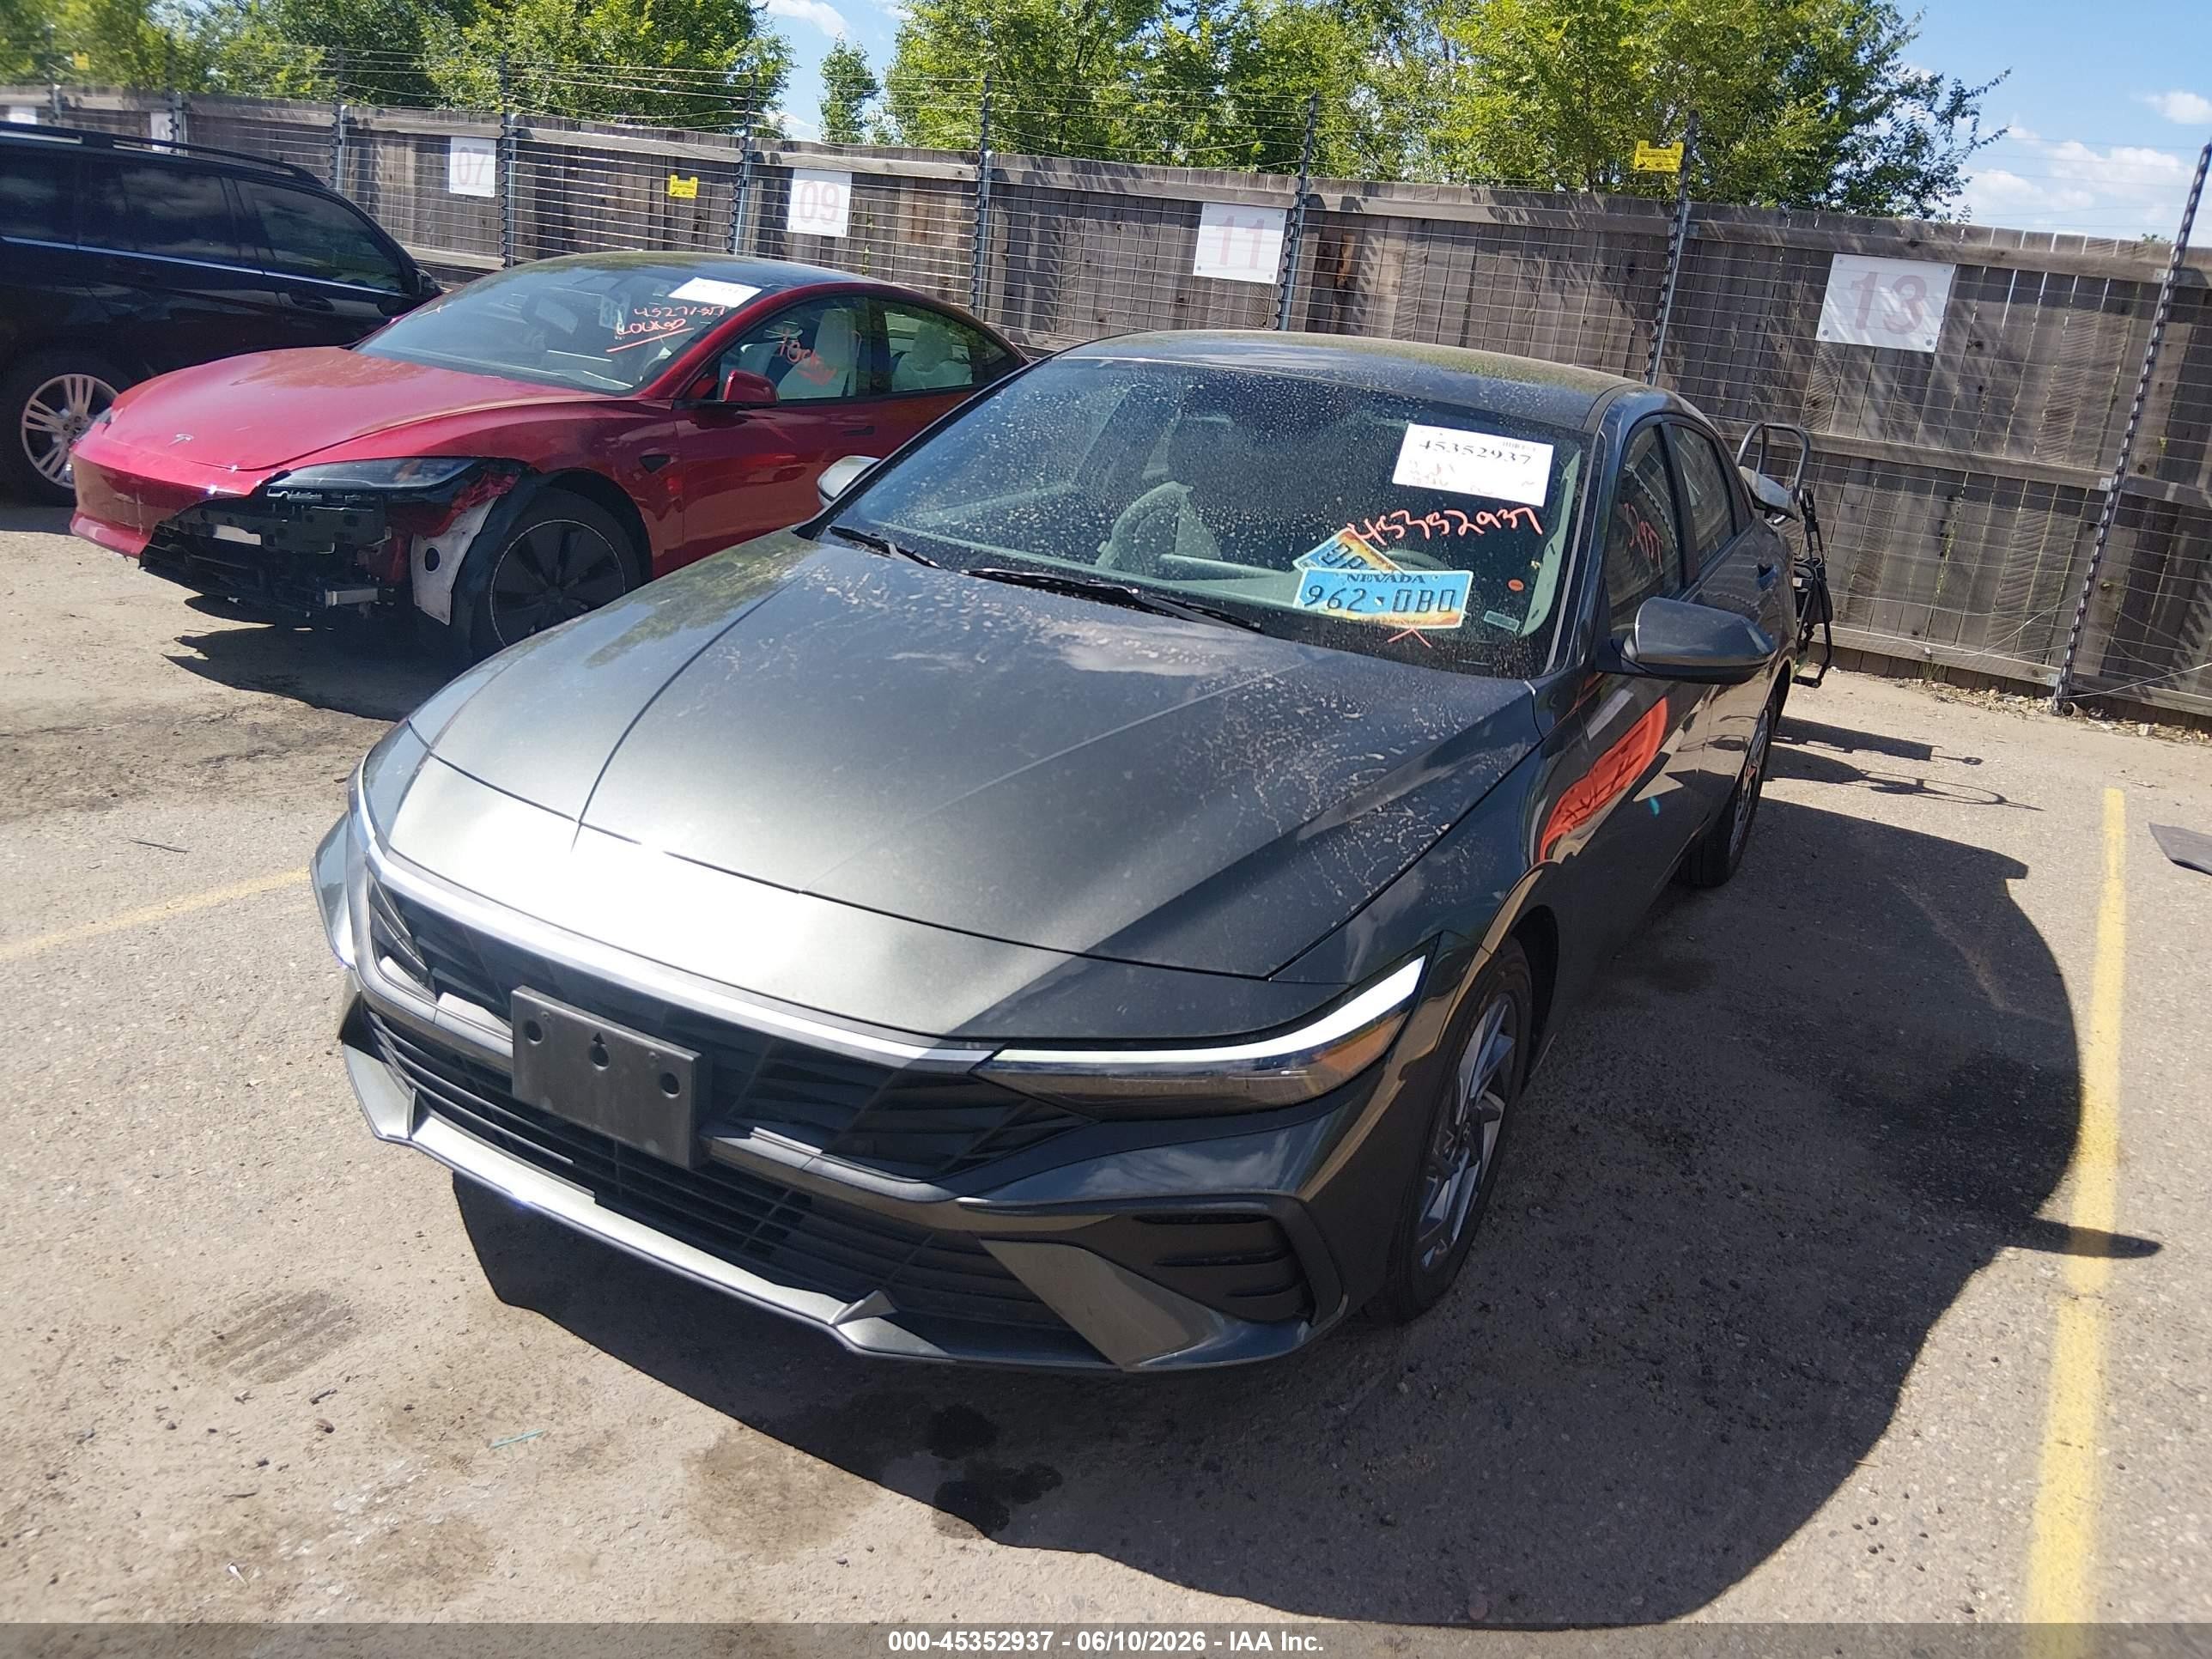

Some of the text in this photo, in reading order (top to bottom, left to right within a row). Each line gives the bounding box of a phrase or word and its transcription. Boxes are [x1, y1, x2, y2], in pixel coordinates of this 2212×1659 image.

[457, 146, 489, 185] 07
[799, 180, 840, 226] 09
[1215, 215, 1265, 270] 11
[1850, 270, 1928, 335] 13
[1418, 440, 1533, 465] 45352937
[1346, 573, 1426, 584] NEVADA
[1304, 585, 1367, 612] 962
